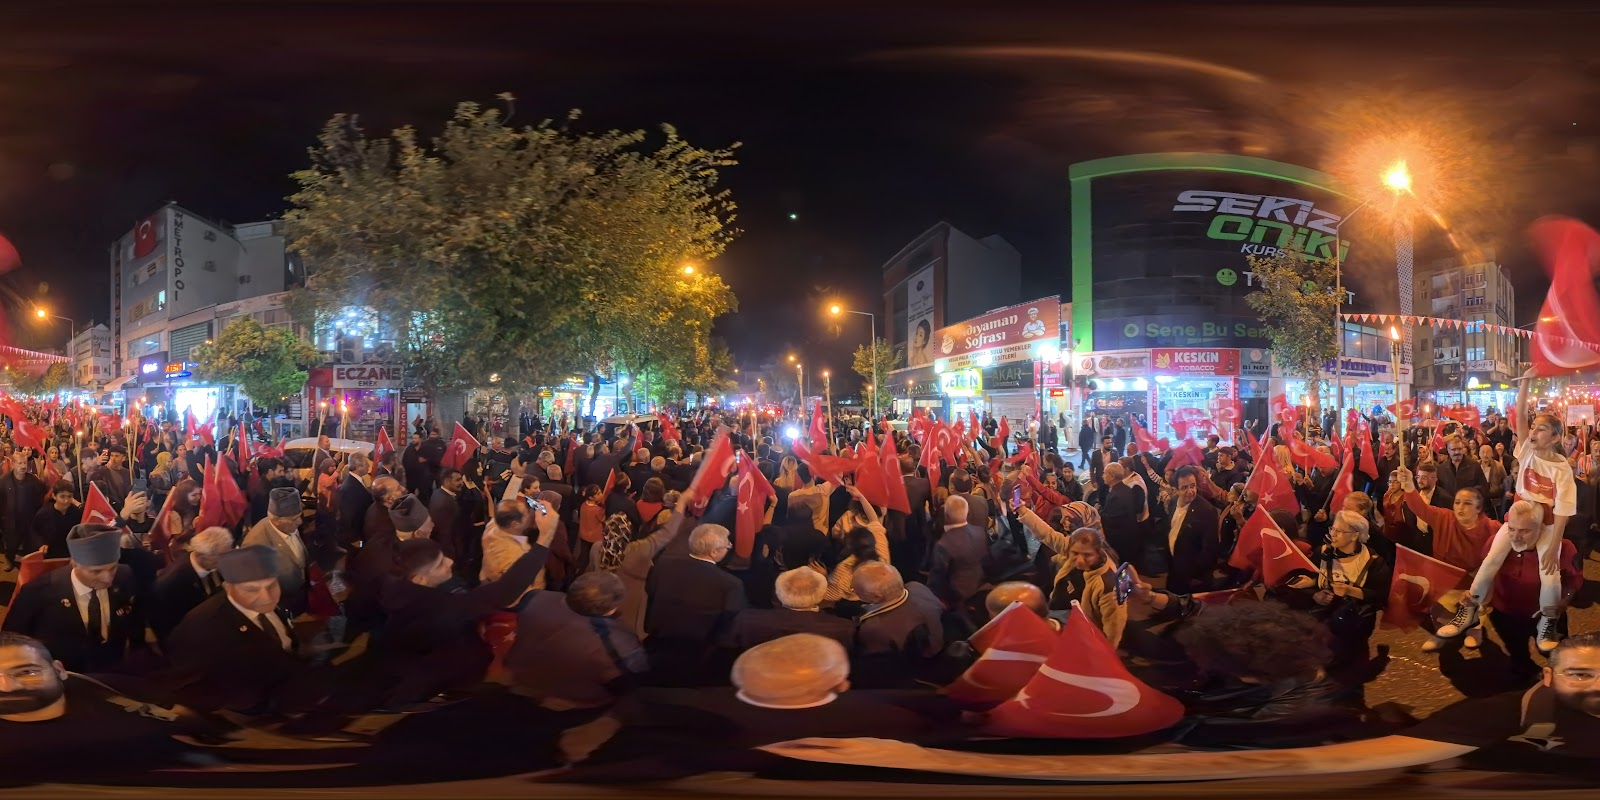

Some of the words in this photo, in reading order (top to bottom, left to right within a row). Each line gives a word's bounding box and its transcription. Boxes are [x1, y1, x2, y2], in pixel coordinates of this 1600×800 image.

[1145, 323, 1197, 337] Sene
[1202, 322, 1228, 337] Bu
[1234, 323, 1269, 338] Sen
[1003, 343, 1032, 353] YEMEKLER
[336, 367, 401, 381] ECZANE
[992, 367, 1022, 382] AKAR
